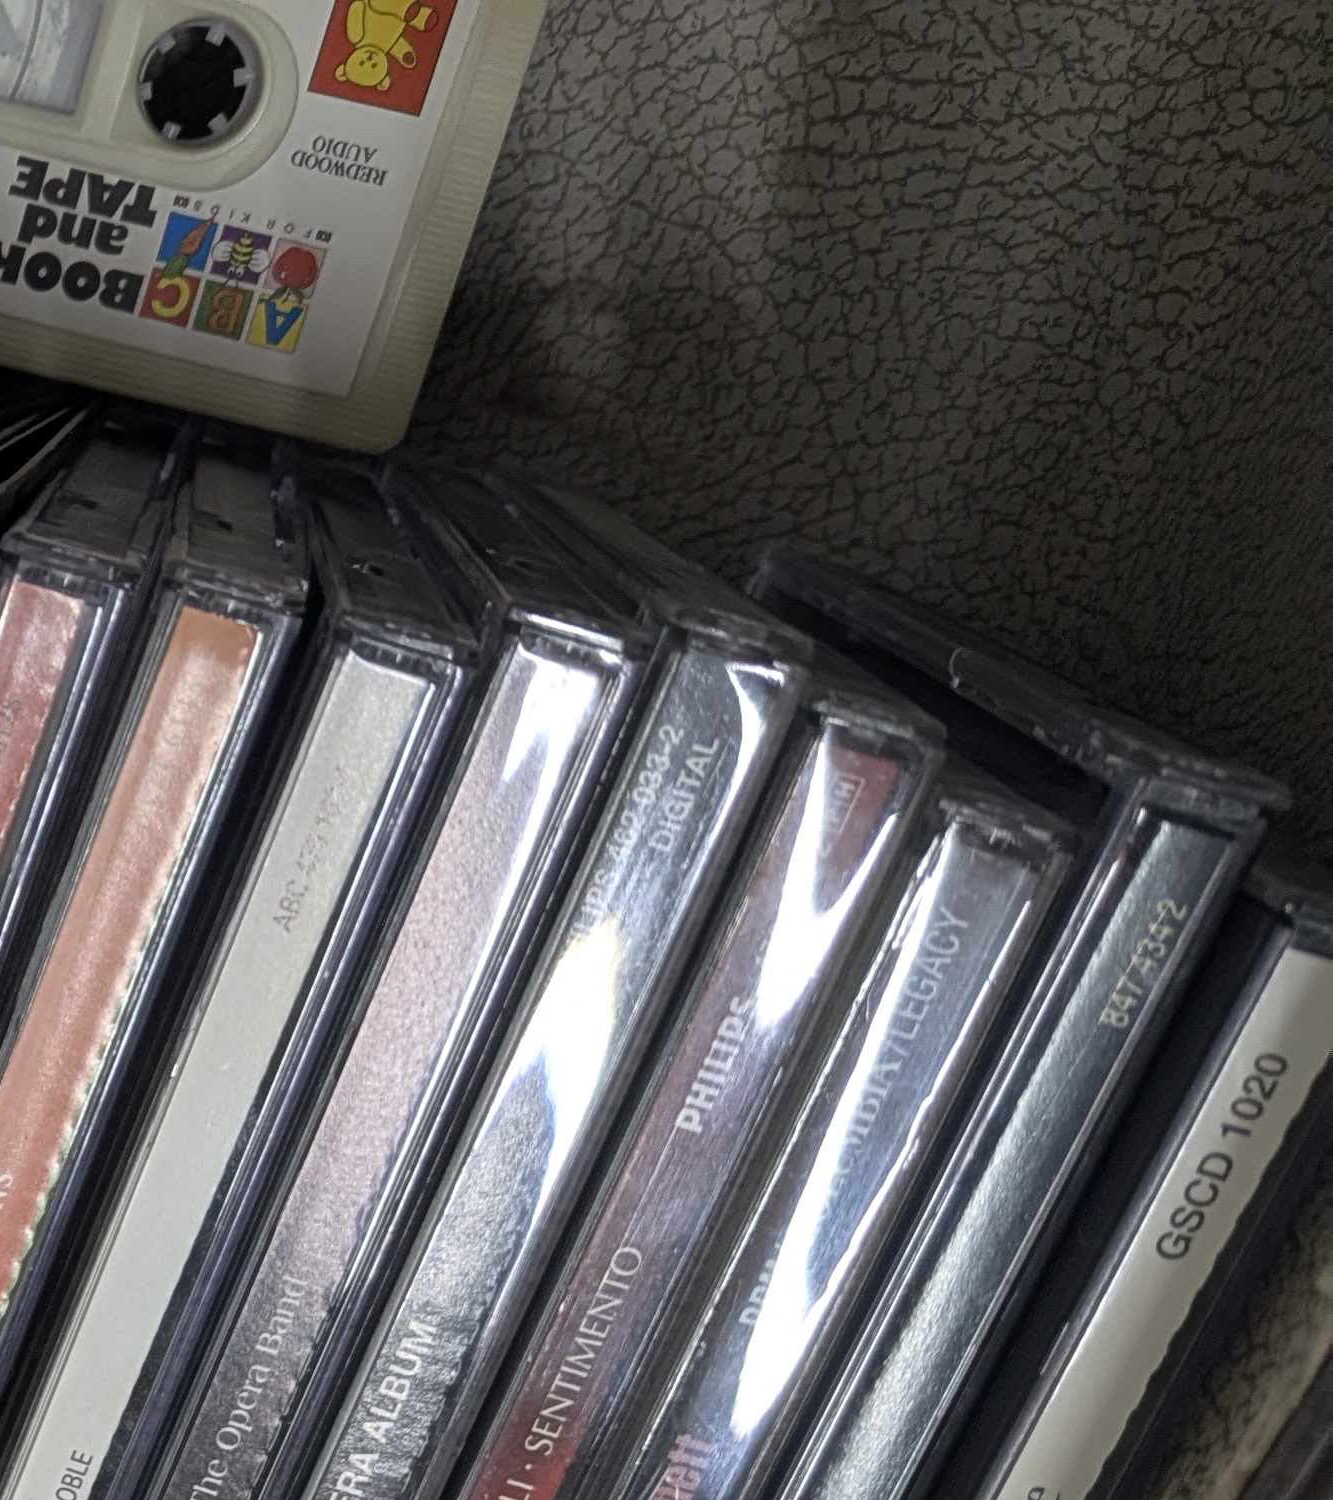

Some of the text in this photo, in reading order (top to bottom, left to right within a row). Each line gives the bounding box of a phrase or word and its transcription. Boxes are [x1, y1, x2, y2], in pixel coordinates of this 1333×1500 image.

[8, 156, 158, 228] TAPE
[17, 203, 129, 255] and
[1150, 1044, 1287, 1259] GSCD 1020
[522, 1244, 641, 1457] SENTIMENTO
[210, 1364, 270, 1450] Opera
